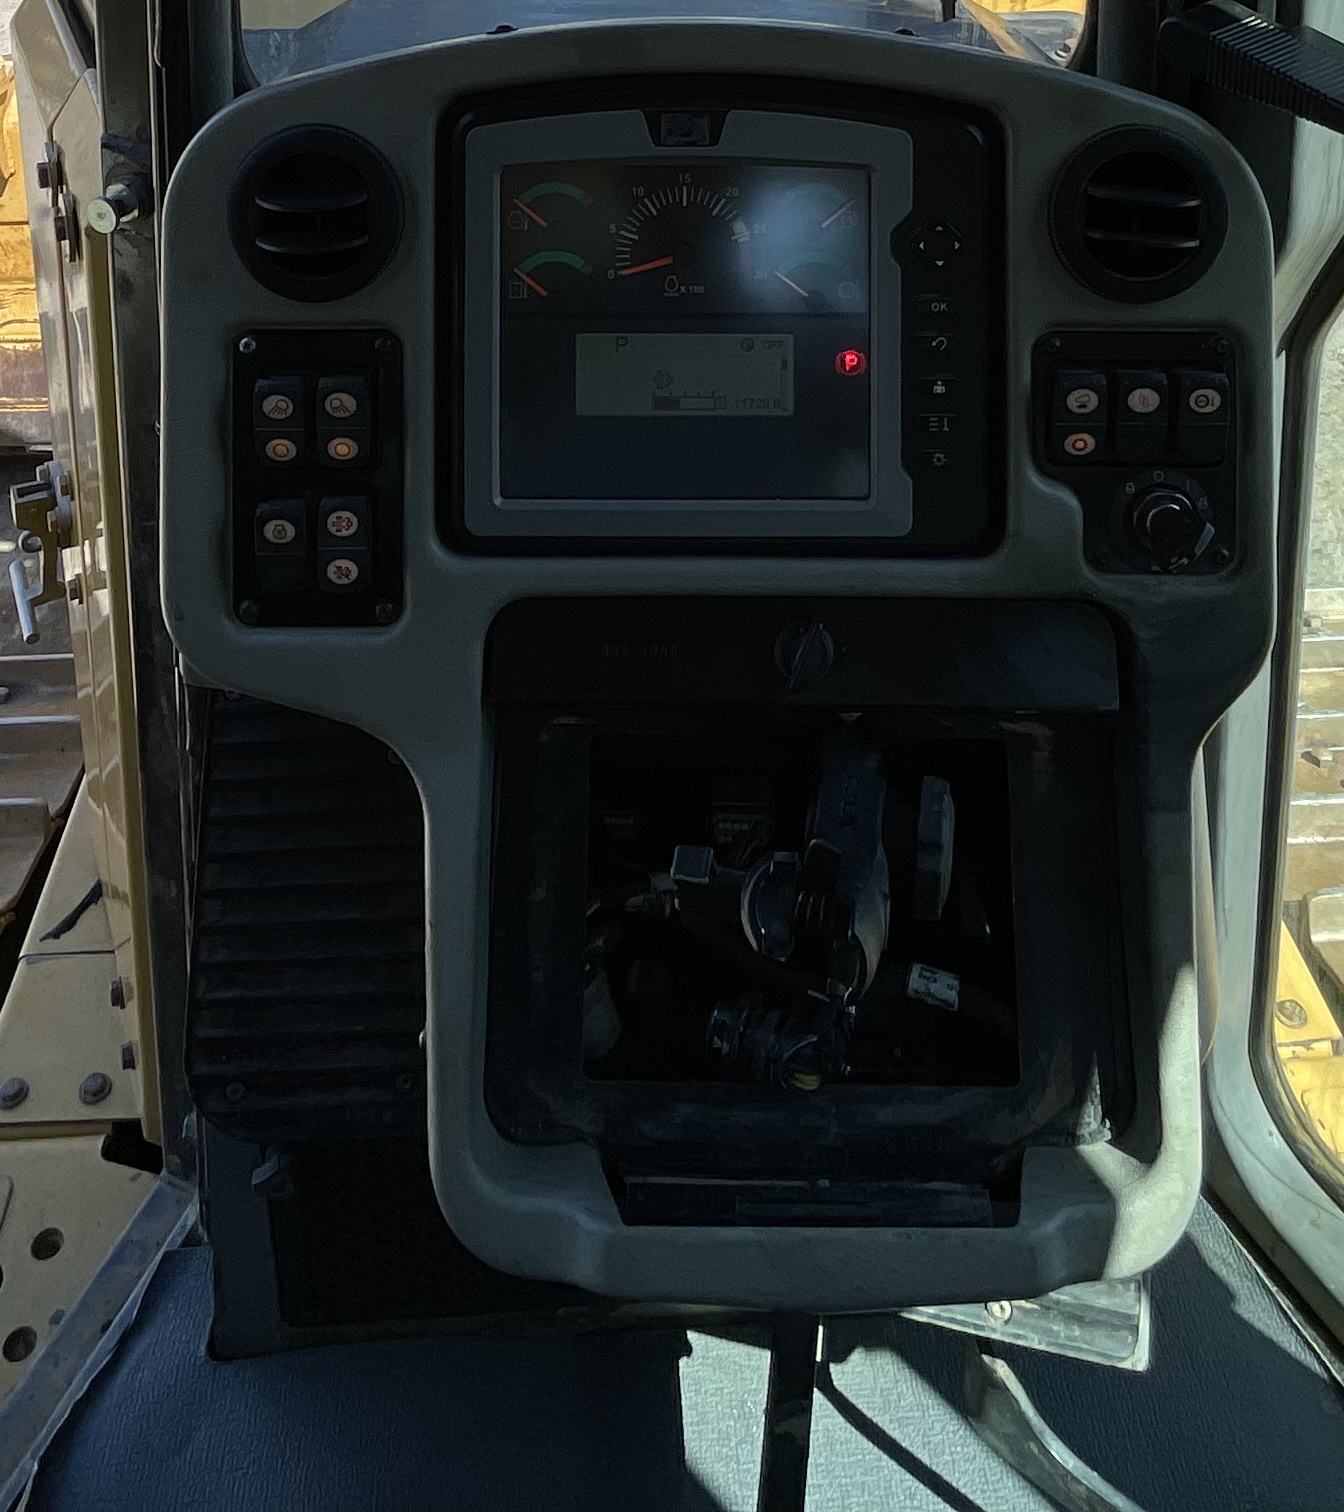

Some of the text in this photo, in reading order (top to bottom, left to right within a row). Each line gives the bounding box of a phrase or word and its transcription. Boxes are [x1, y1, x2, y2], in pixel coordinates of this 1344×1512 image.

[678, 173, 692, 183] 15
[631, 187, 645, 197] 10
[725, 187, 740, 197] 20
[753, 224, 768, 235] 25
[753, 270, 768, 280] 30
[931, 302, 949, 312] OK
[615, 336, 629, 352] P
